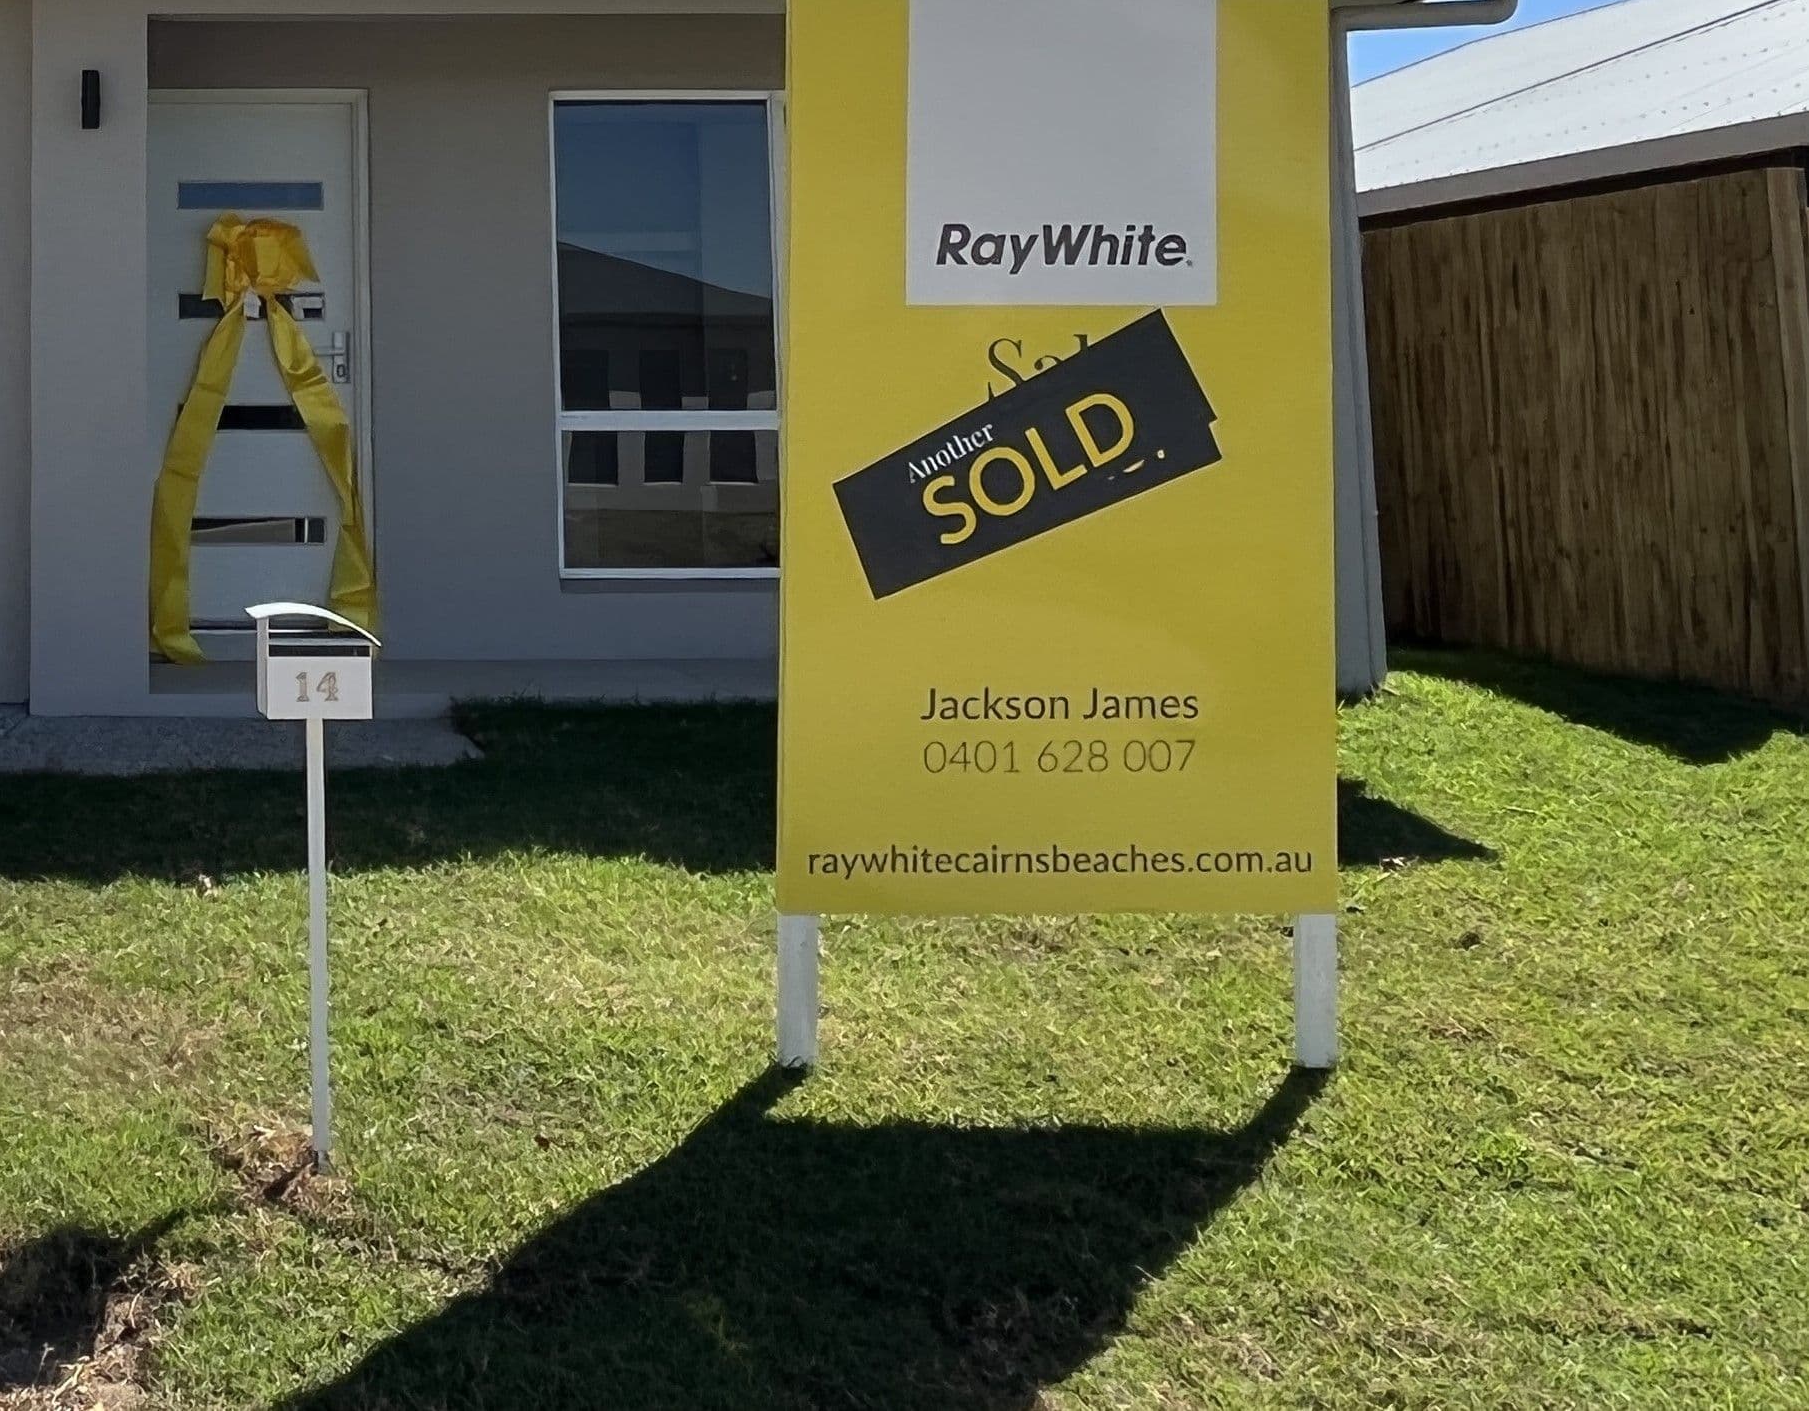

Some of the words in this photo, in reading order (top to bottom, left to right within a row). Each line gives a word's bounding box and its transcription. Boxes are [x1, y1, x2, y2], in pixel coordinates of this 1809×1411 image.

[908, 423, 993, 484] Another
[295, 671, 339, 702] 14
[920, 686, 1069, 720] Jackson
[1083, 687, 1198, 720] James
[923, 740, 1020, 773] 0401
[1037, 739, 1109, 773] 628
[1123, 739, 1196, 773] 007
[808, 844, 1312, 880] raywhitecairnsbeaches.com.au
